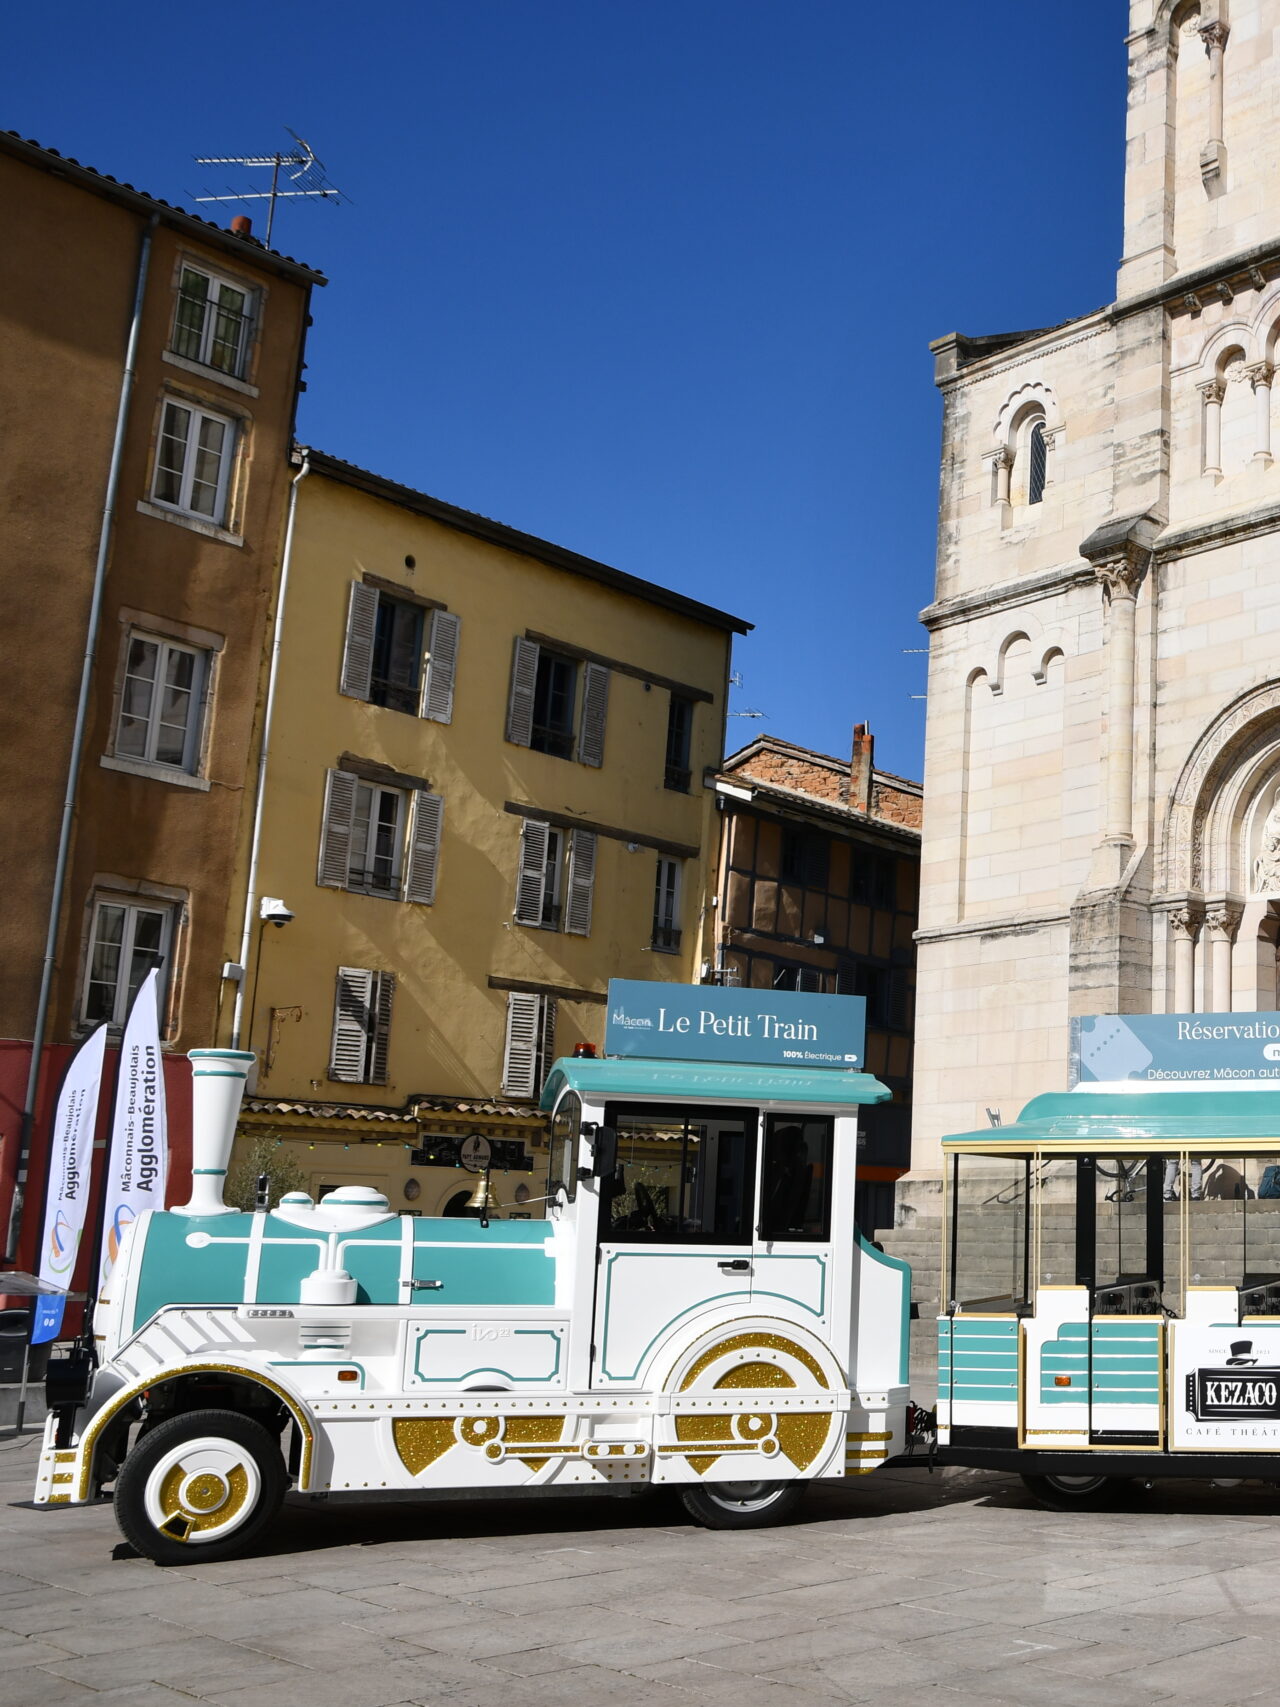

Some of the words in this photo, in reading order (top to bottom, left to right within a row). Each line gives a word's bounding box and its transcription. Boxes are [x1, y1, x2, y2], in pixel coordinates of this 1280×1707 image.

[658, 1008, 690, 1033] Le
[698, 1010, 752, 1037] Petit
[757, 1014, 818, 1041] Train
[783, 1050, 804, 1059] 100%
[804, 1050, 842, 1062] Électrique
[1147, 1068, 1210, 1080] Découvrez
[1213, 1068, 1255, 1079] Mâcon
[120, 1045, 140, 1192] Mâconnais-Beaujolais
[136, 1045, 158, 1192] Agglomération
[1205, 1381, 1277, 1406] KEZACO
[1185, 1427, 1221, 1436] CAFÉ
